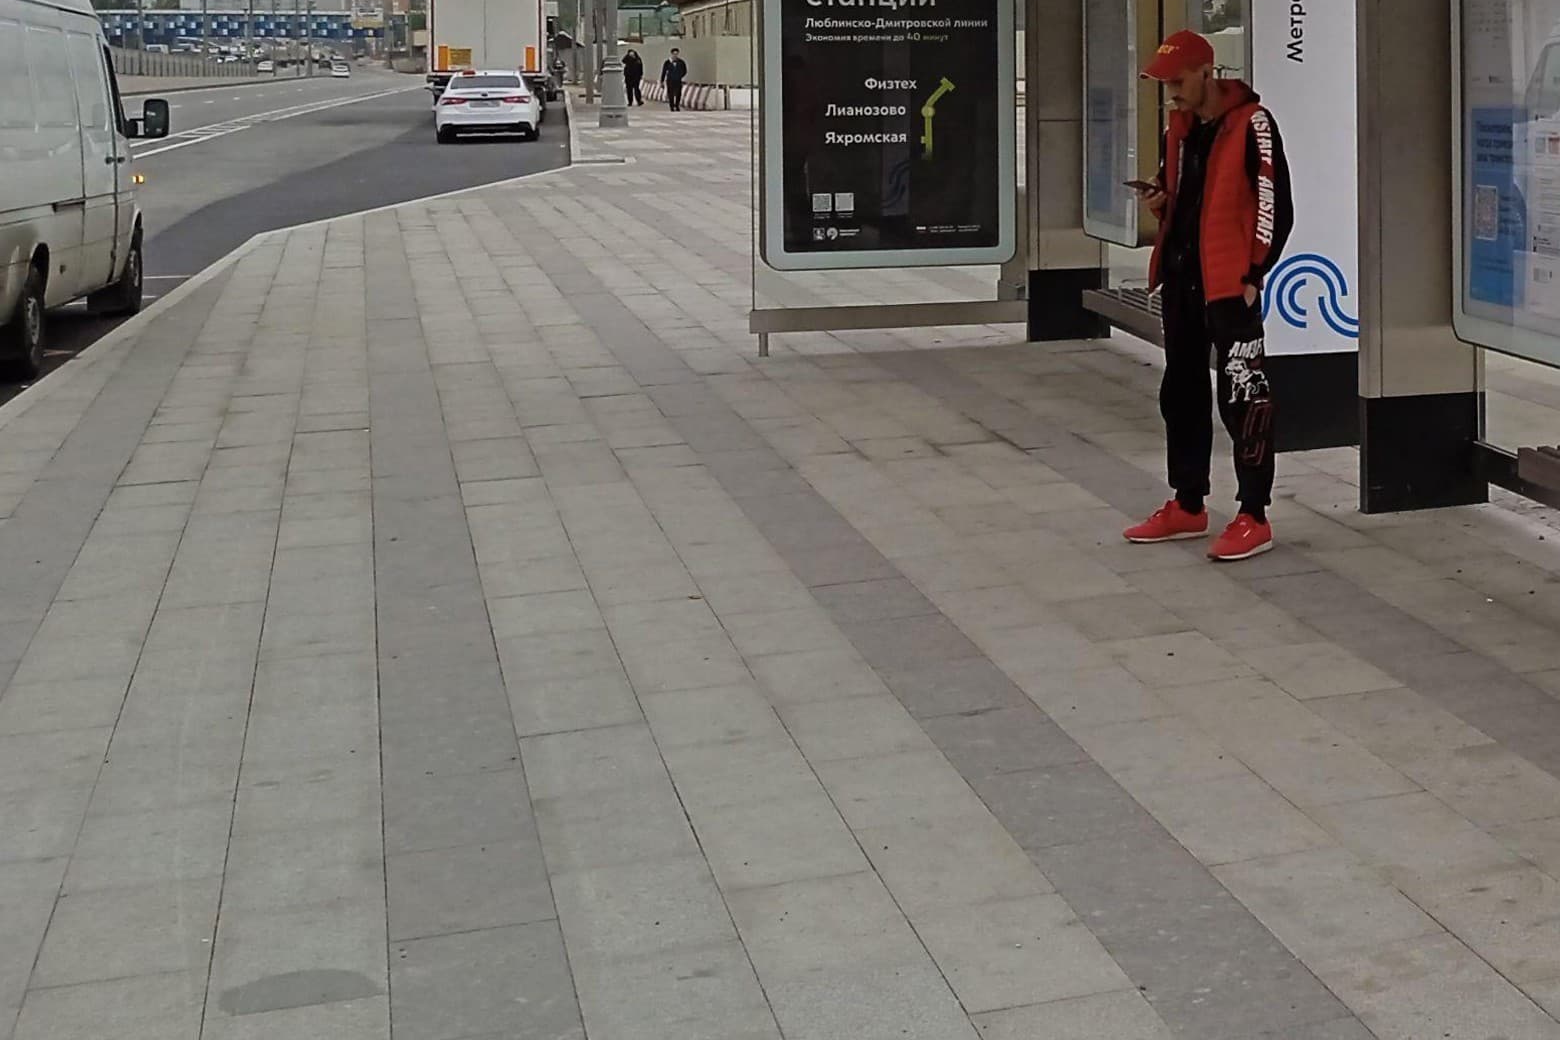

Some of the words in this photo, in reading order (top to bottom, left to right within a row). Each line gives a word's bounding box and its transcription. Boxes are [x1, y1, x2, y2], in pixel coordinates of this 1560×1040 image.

[804, 16, 951, 30] Люблинско-Дмитровской
[953, 19, 988, 28] линии
[906, 32, 921, 41] 40
[864, 77, 917, 91] Физтех
[825, 103, 906, 117] Лианозово
[825, 131, 907, 147] Яхромская
[1256, 175, 1274, 247] AMSTAFF
